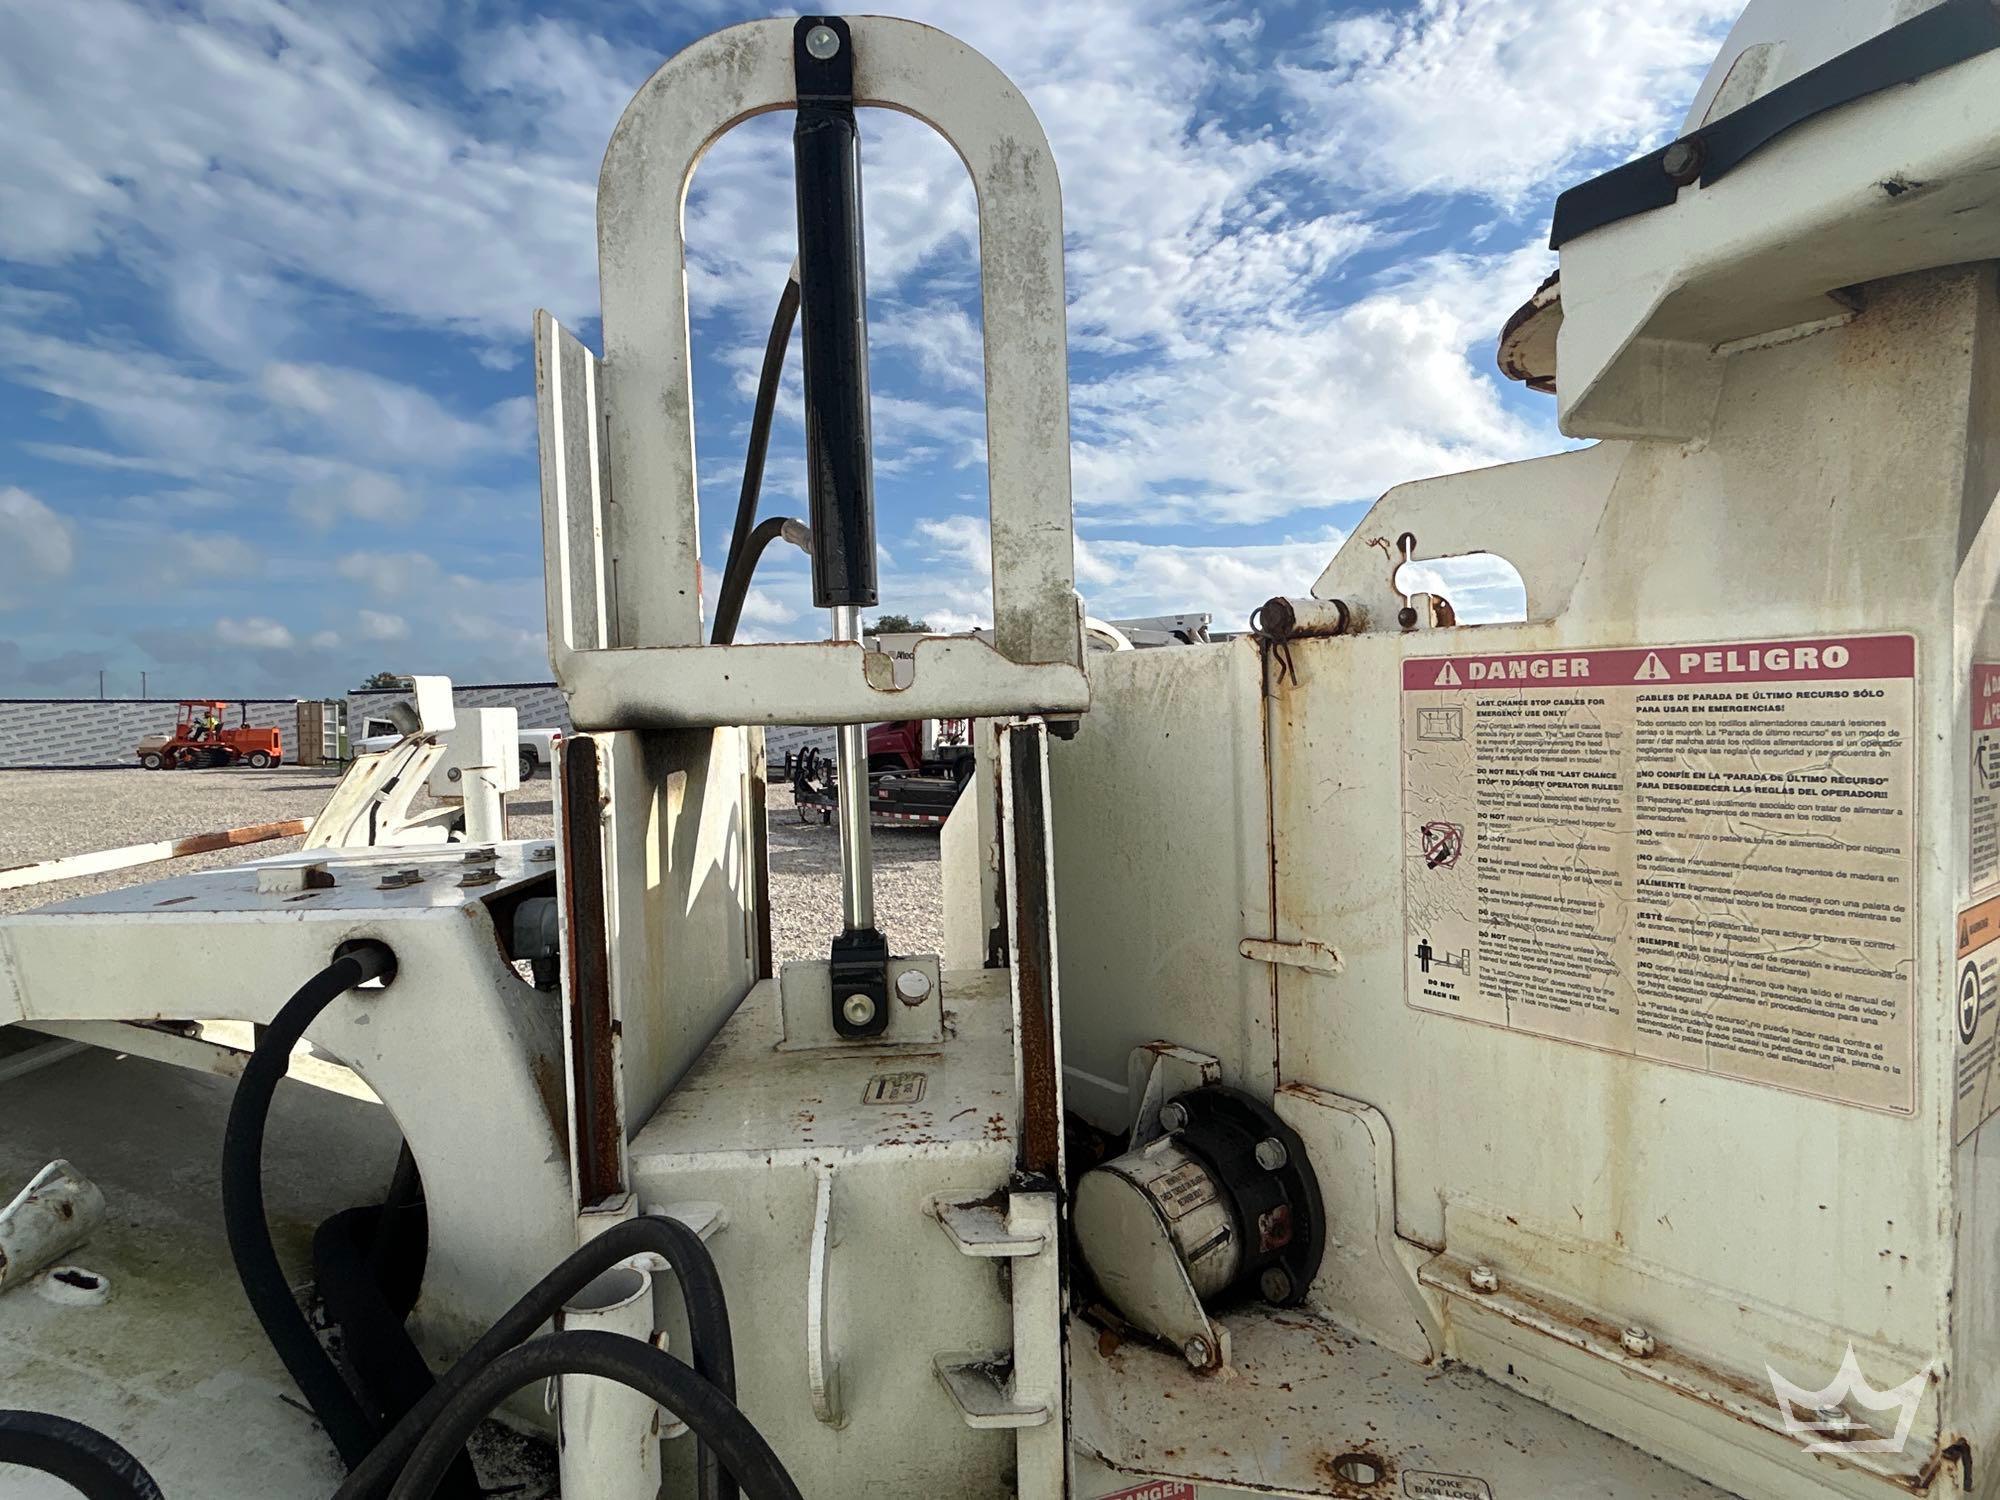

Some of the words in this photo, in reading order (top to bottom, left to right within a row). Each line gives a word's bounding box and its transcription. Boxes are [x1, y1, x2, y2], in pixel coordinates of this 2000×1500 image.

[1679, 645, 1850, 674] PELIGRO
[1469, 657, 1590, 681] DANGER
[1752, 691, 1793, 699] ÚLTIMO
[1795, 691, 1849, 699] RECURSO
[1852, 689, 1884, 698] SÓLO
[1656, 769, 1690, 778] CONFÍE
[1786, 773, 1827, 783] ÚLTIMO
[1830, 776, 1889, 785] RECURSO"
[1546, 781, 1589, 789] OPERATOR
[1662, 783, 1730, 792] DESOBEDECER
[1732, 785, 1751, 793] LAS
[1754, 786, 1795, 794] REGLAS
[1440, 981, 1455, 989] NOT
[1428, 1478, 1462, 1488] YOKE
[1115, 1481, 1185, 1500] NGER
[1415, 1485, 1441, 1496] BAR
